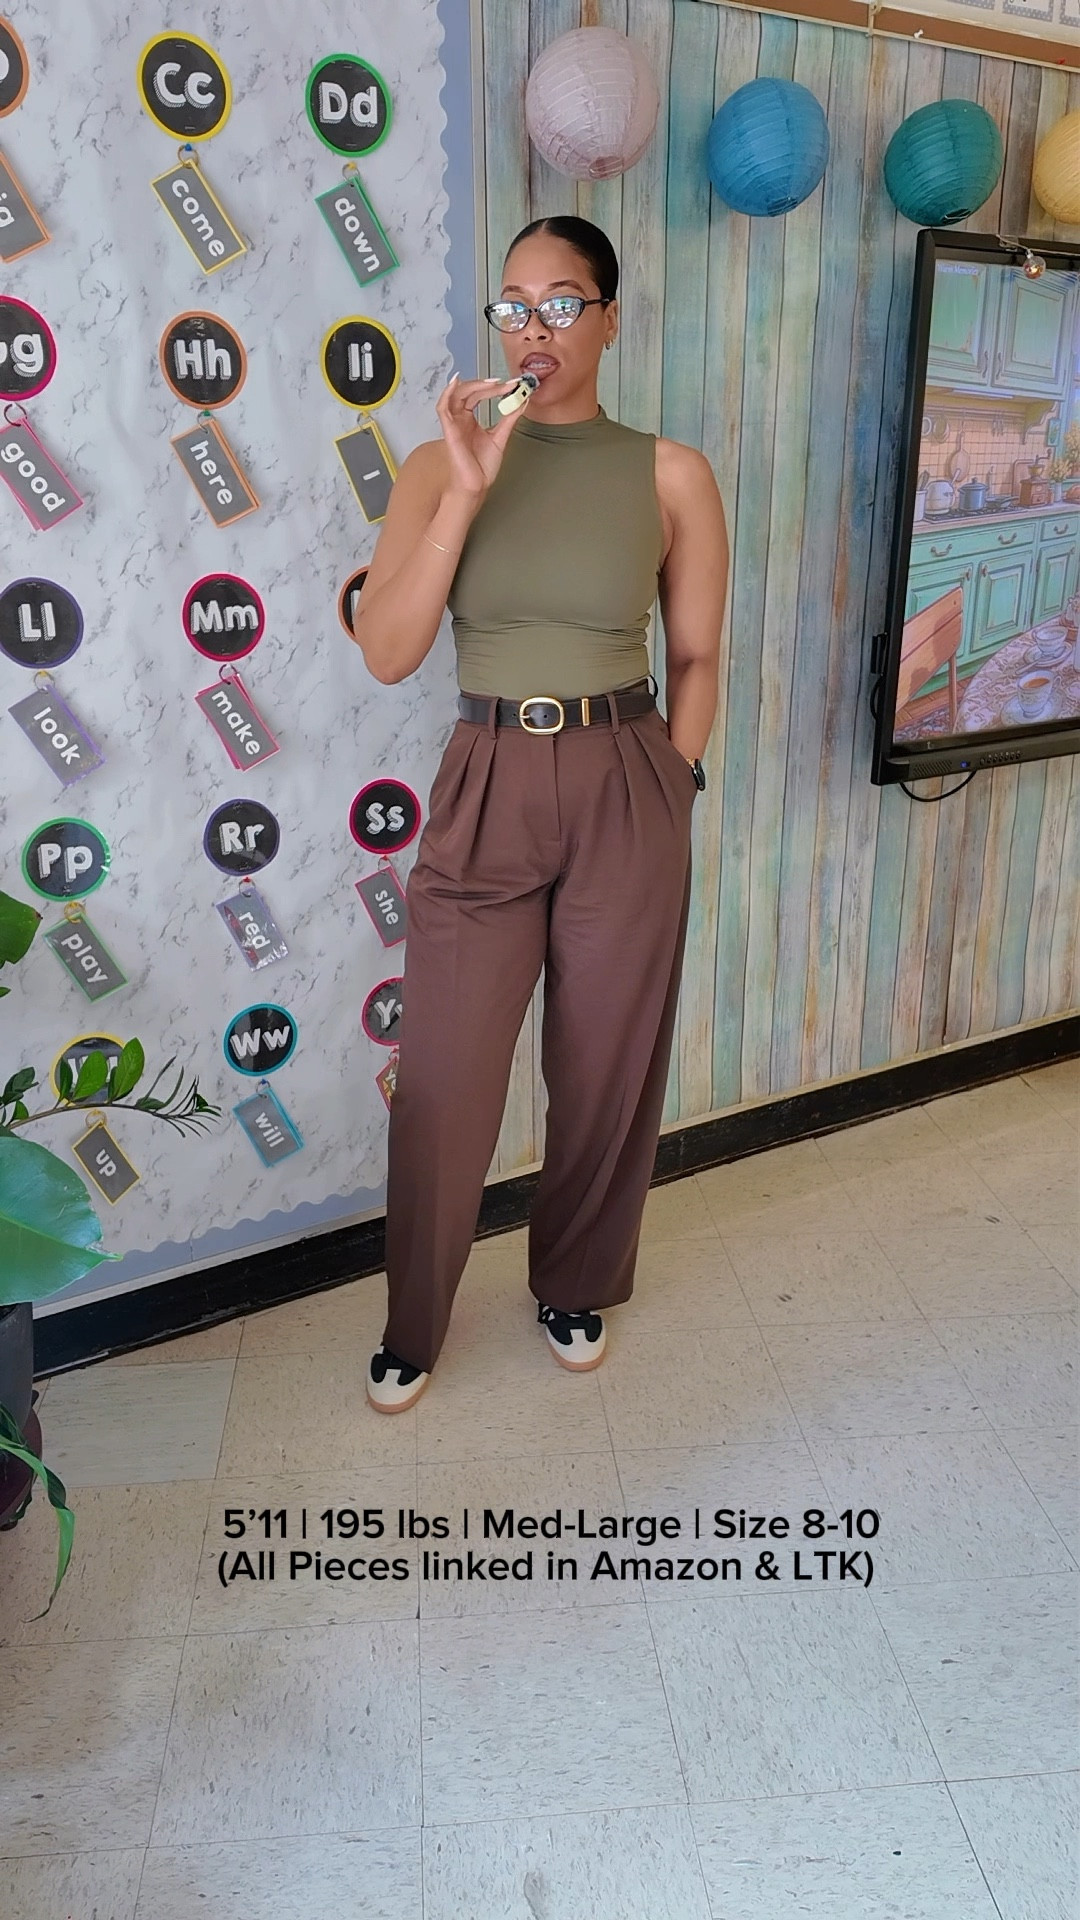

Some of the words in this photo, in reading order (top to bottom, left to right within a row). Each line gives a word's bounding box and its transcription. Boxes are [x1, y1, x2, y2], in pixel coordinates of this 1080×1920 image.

[153, 62, 215, 109] Cc
[319, 82, 378, 127] Dd
[171, 179, 225, 258] come
[334, 198, 381, 273] down
[0, 334, 44, 377] g
[174, 339, 232, 380] Hh
[1, 442, 65, 512] good
[190, 440, 233, 505] here
[18, 602, 56, 641] Ll
[191, 600, 259, 634] Mm
[33, 707, 80, 764] look
[211, 690, 261, 756] make
[219, 822, 264, 855] Rr
[365, 803, 404, 834] Ss
[37, 843, 93, 882] Pp
[375, 890, 398, 925] she
[239, 912, 270, 949] red
[61, 932, 108, 984] play
[230, 1025, 290, 1060] Ww
[255, 1111, 283, 1148] will
[95, 1149, 116, 1177] up
